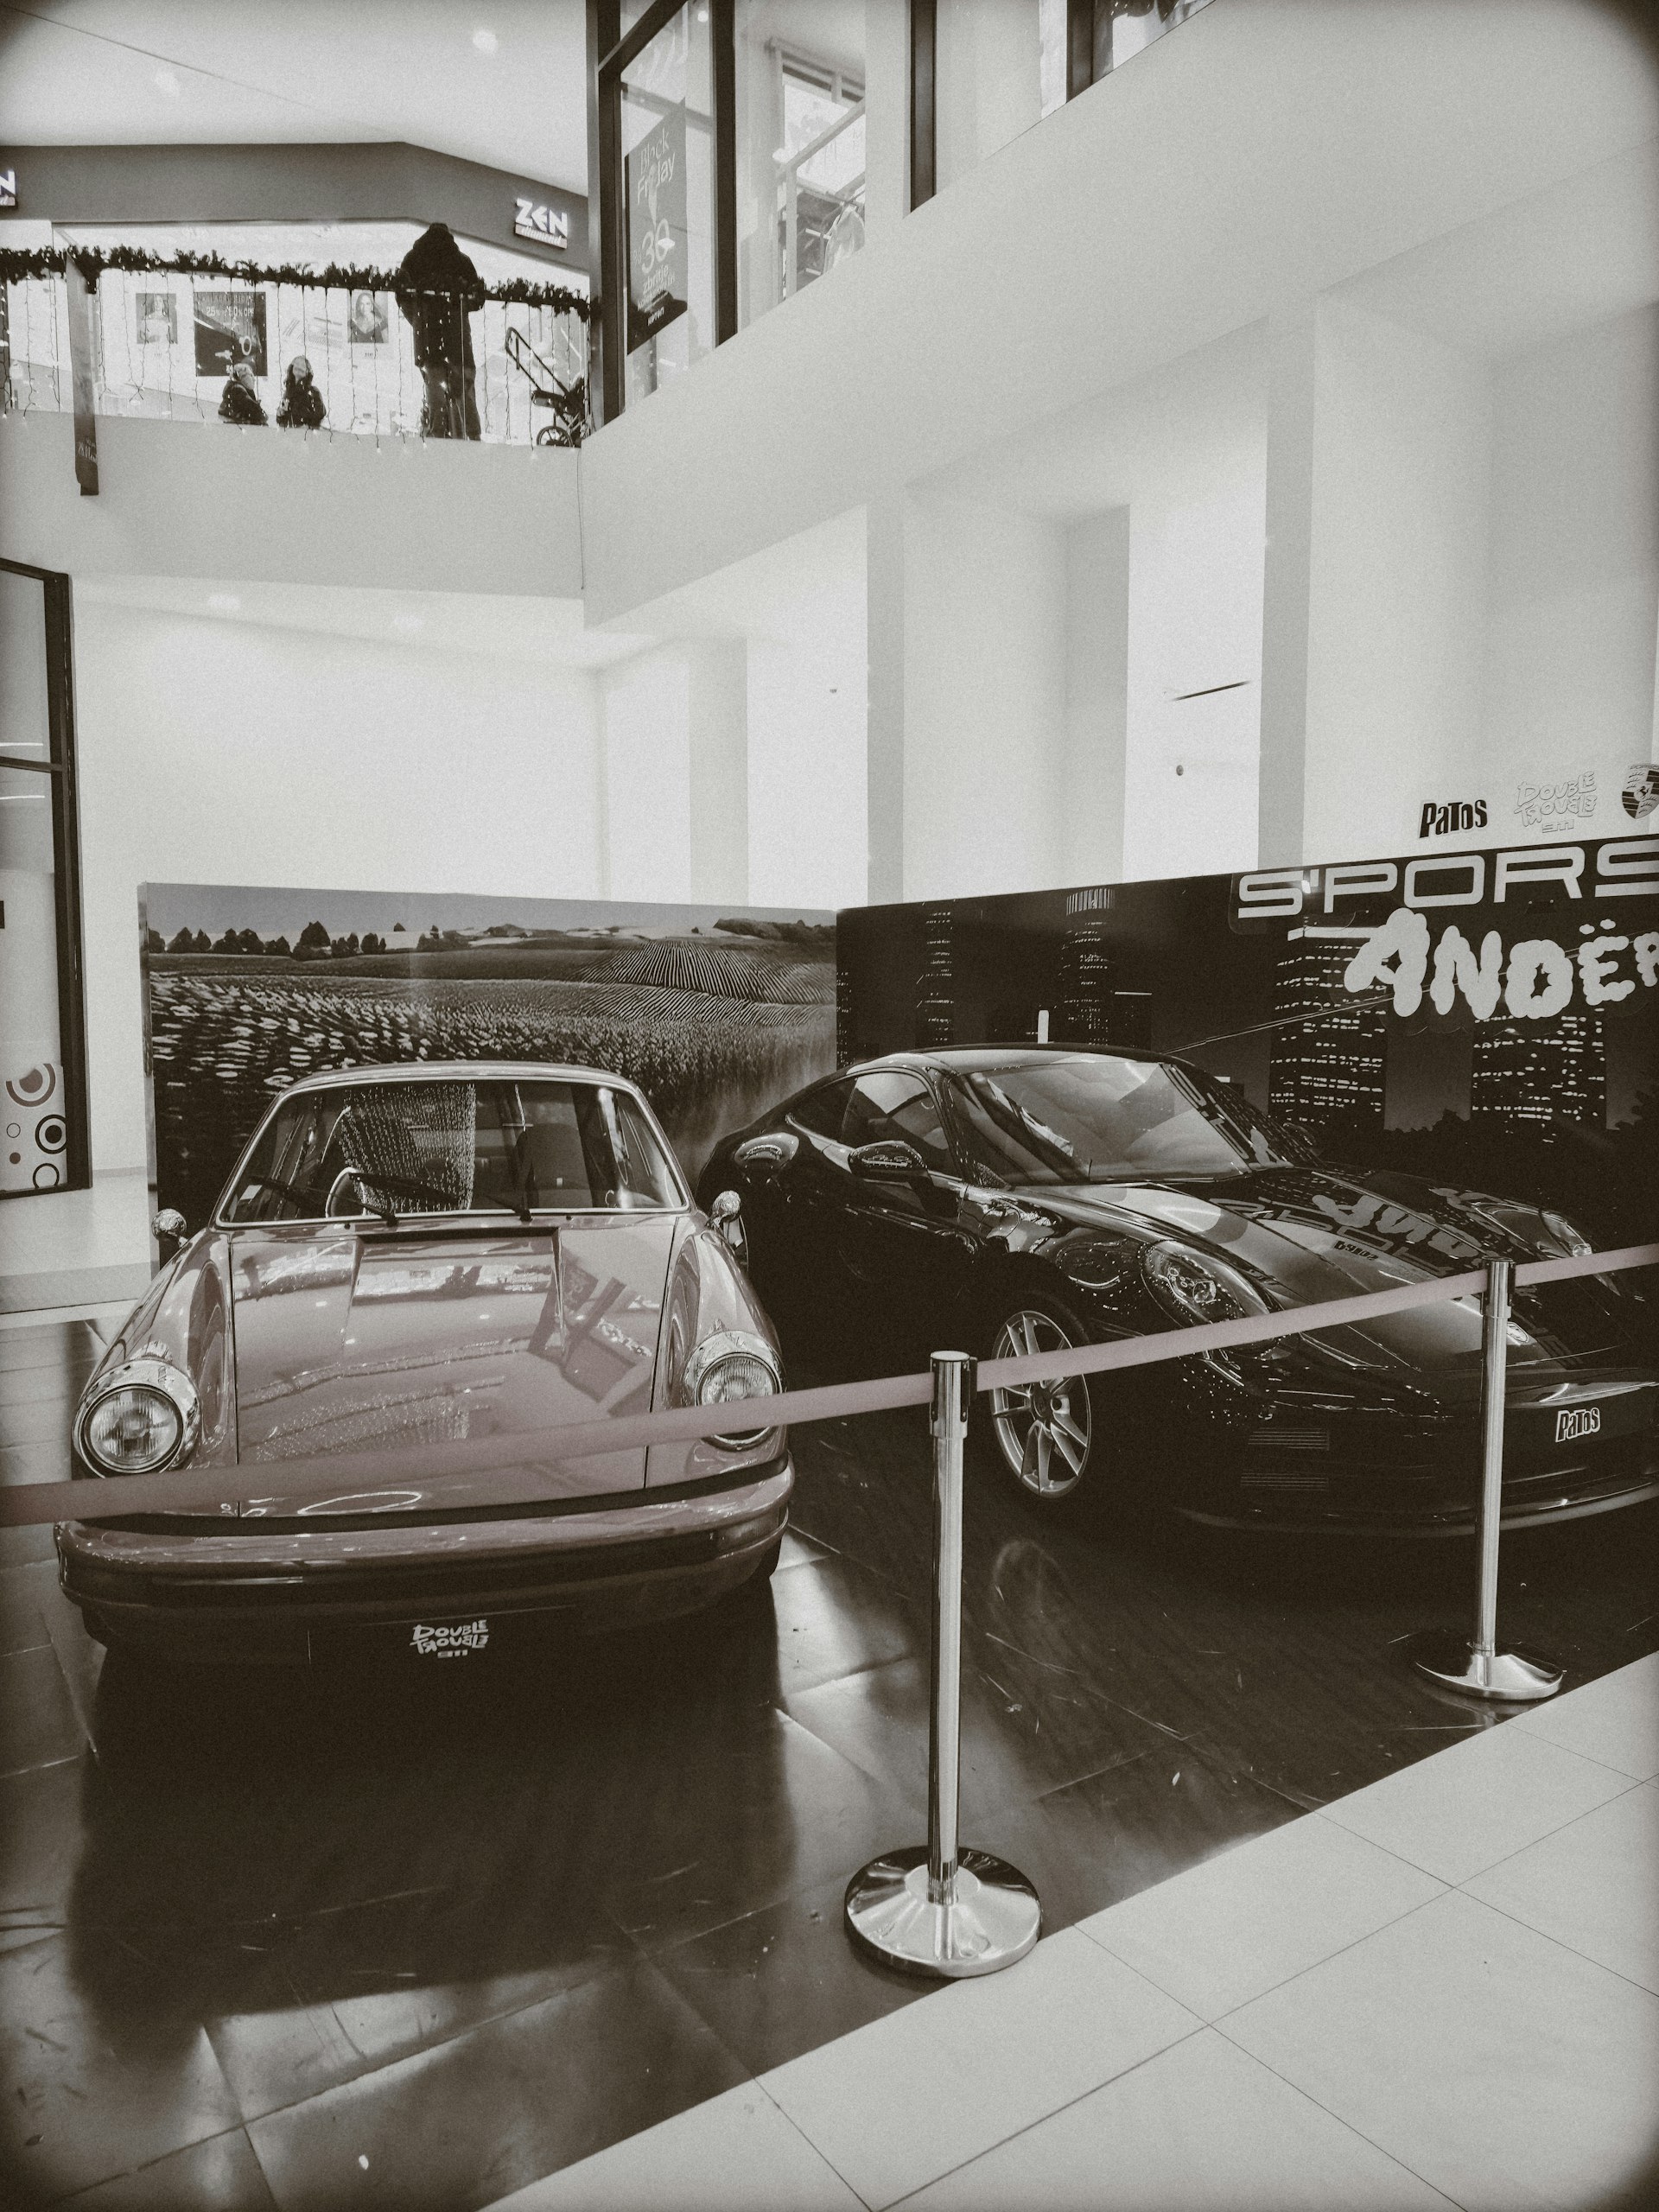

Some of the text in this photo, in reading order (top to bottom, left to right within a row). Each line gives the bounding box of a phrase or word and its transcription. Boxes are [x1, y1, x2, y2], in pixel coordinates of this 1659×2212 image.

[516, 198, 569, 238] ZEN
[1517, 771, 1598, 807] DOUBLE
[1514, 794, 1598, 828] TROUBLE
[409, 1634, 489, 1655] TROUBLE
[412, 1619, 489, 1641] DOUBLE
